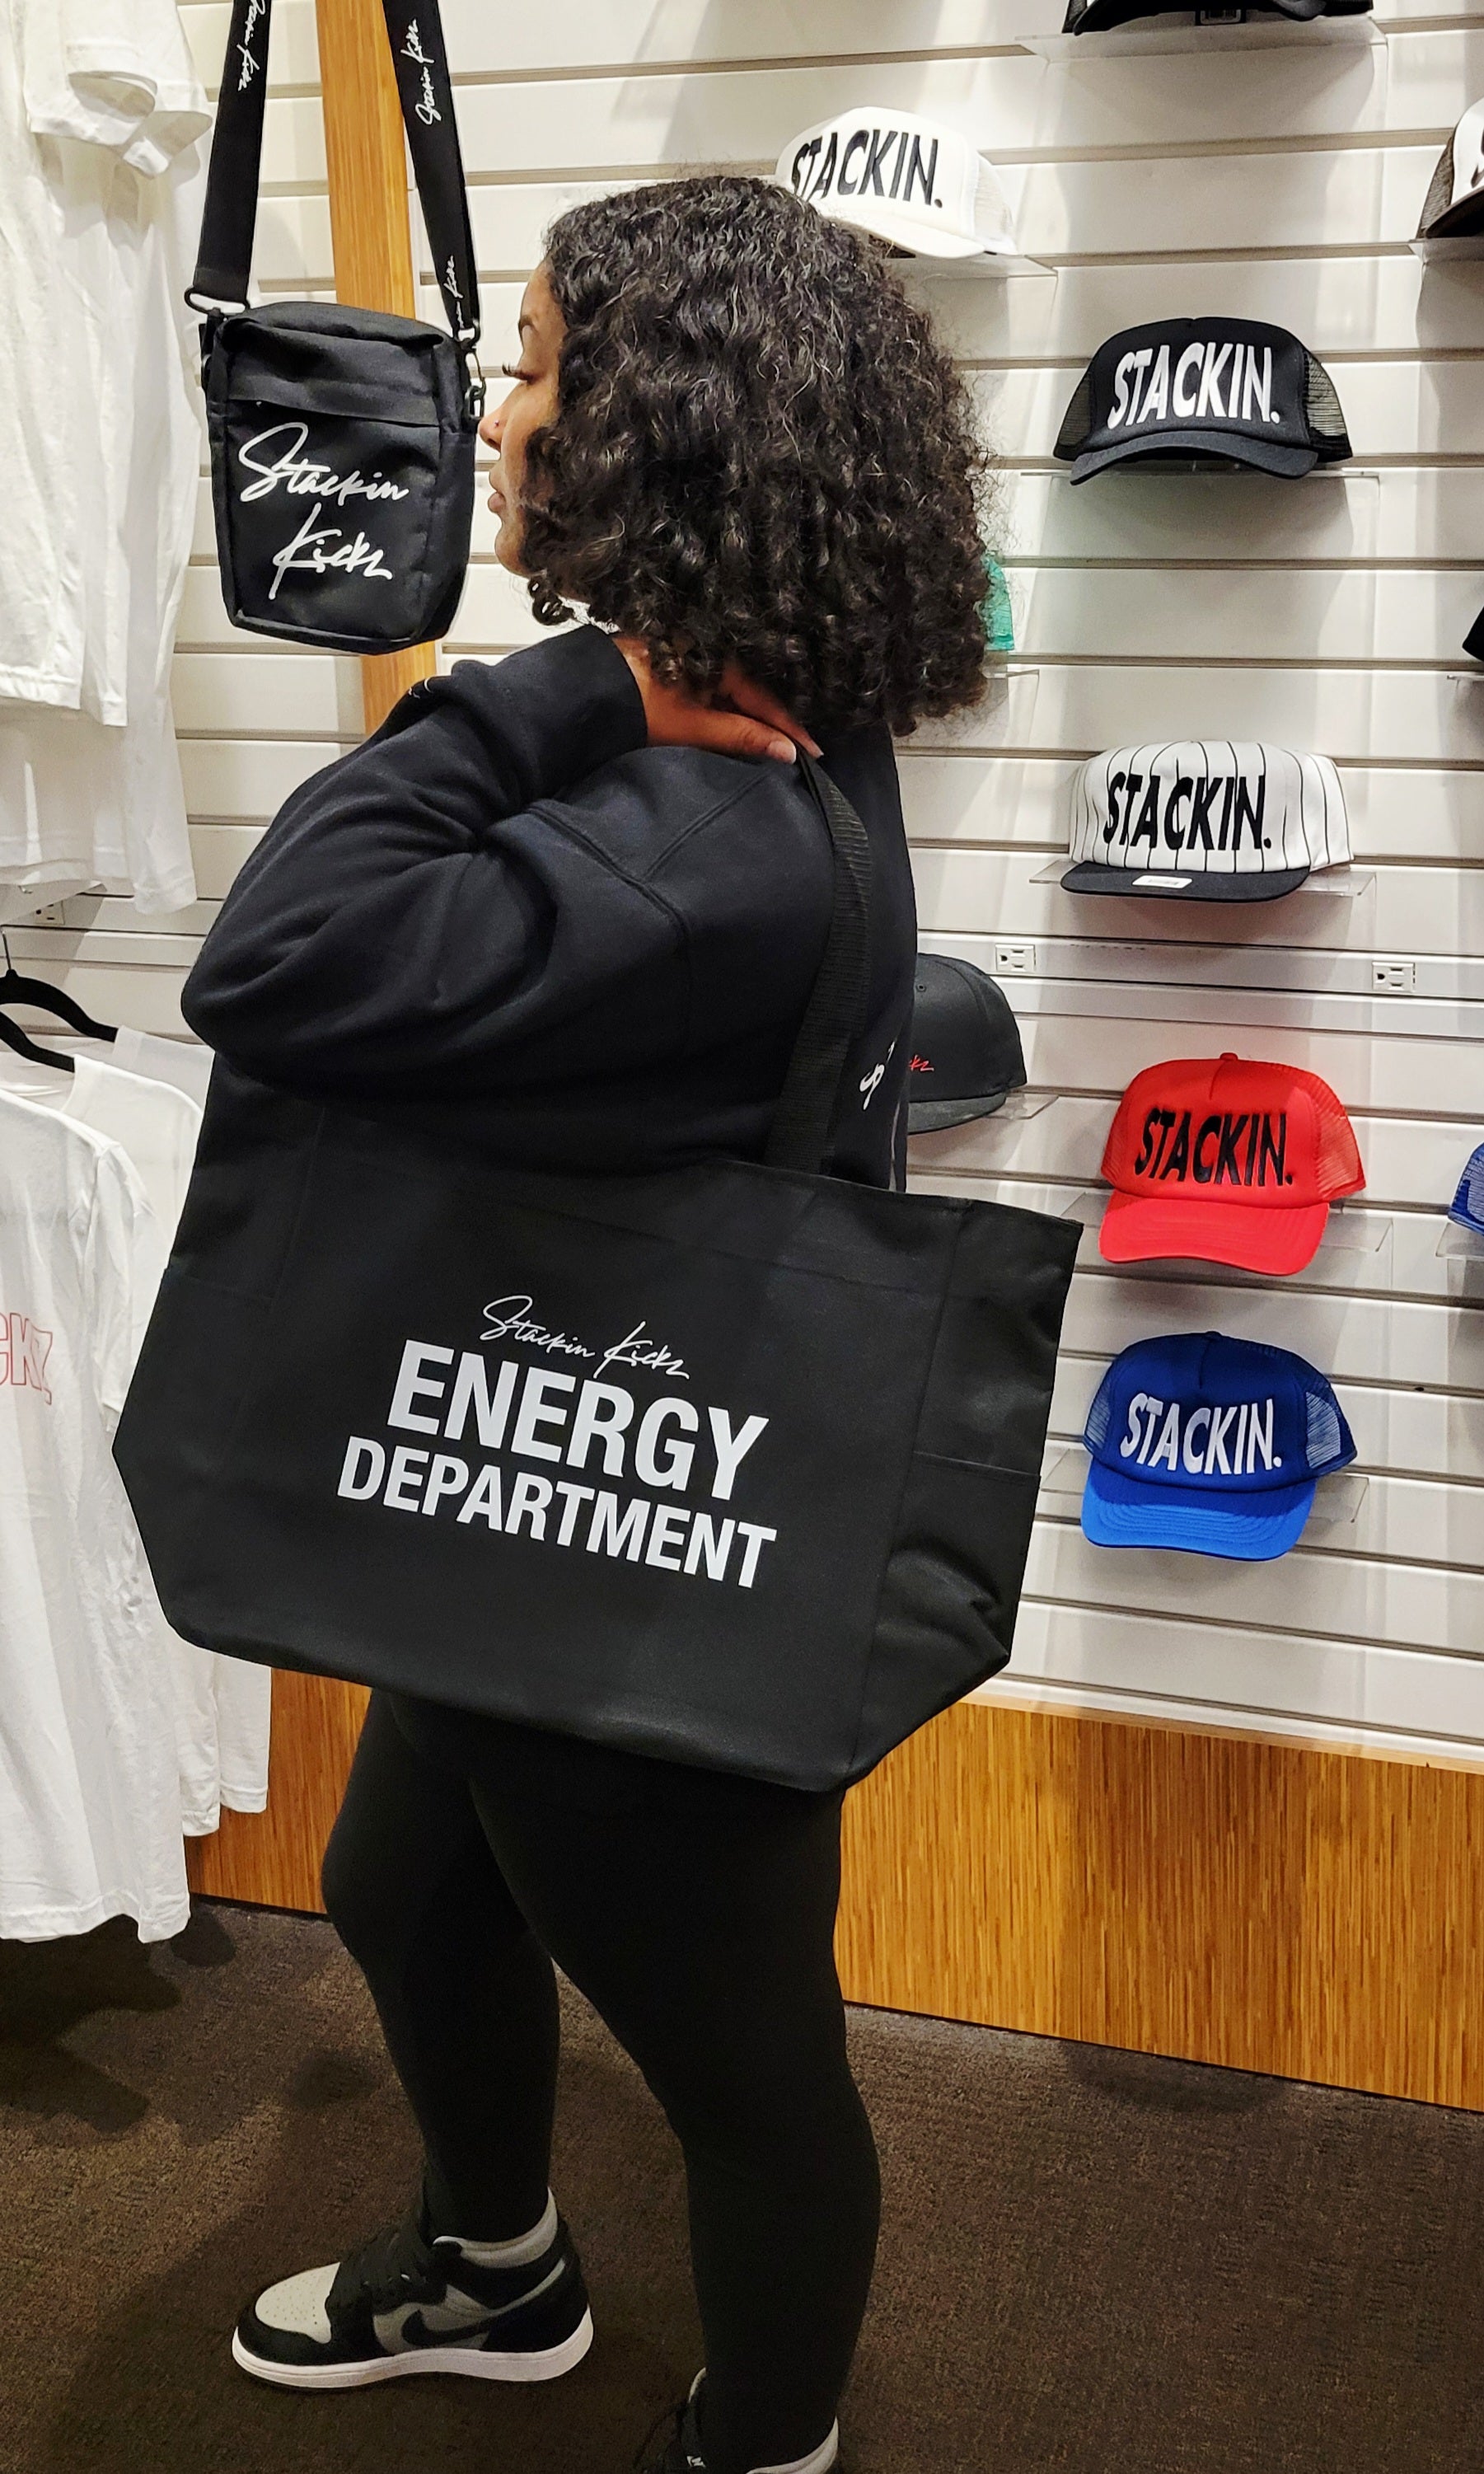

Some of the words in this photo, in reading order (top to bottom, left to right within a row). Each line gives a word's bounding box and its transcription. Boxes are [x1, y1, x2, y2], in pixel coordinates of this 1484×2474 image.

[791, 129, 943, 209] STACKIN.
[1107, 341, 1281, 430] STACKIN.
[238, 421, 410, 507] Stackin
[1102, 771, 1272, 850] STACKIN.
[1133, 1108, 1294, 1188] STACKIN.
[478, 1295, 596, 1360] Stackin
[386, 1338, 770, 1502] ENERGY
[1120, 1391, 1283, 1475] STACKIN.
[336, 1435, 778, 1589] DEPARTMENT
